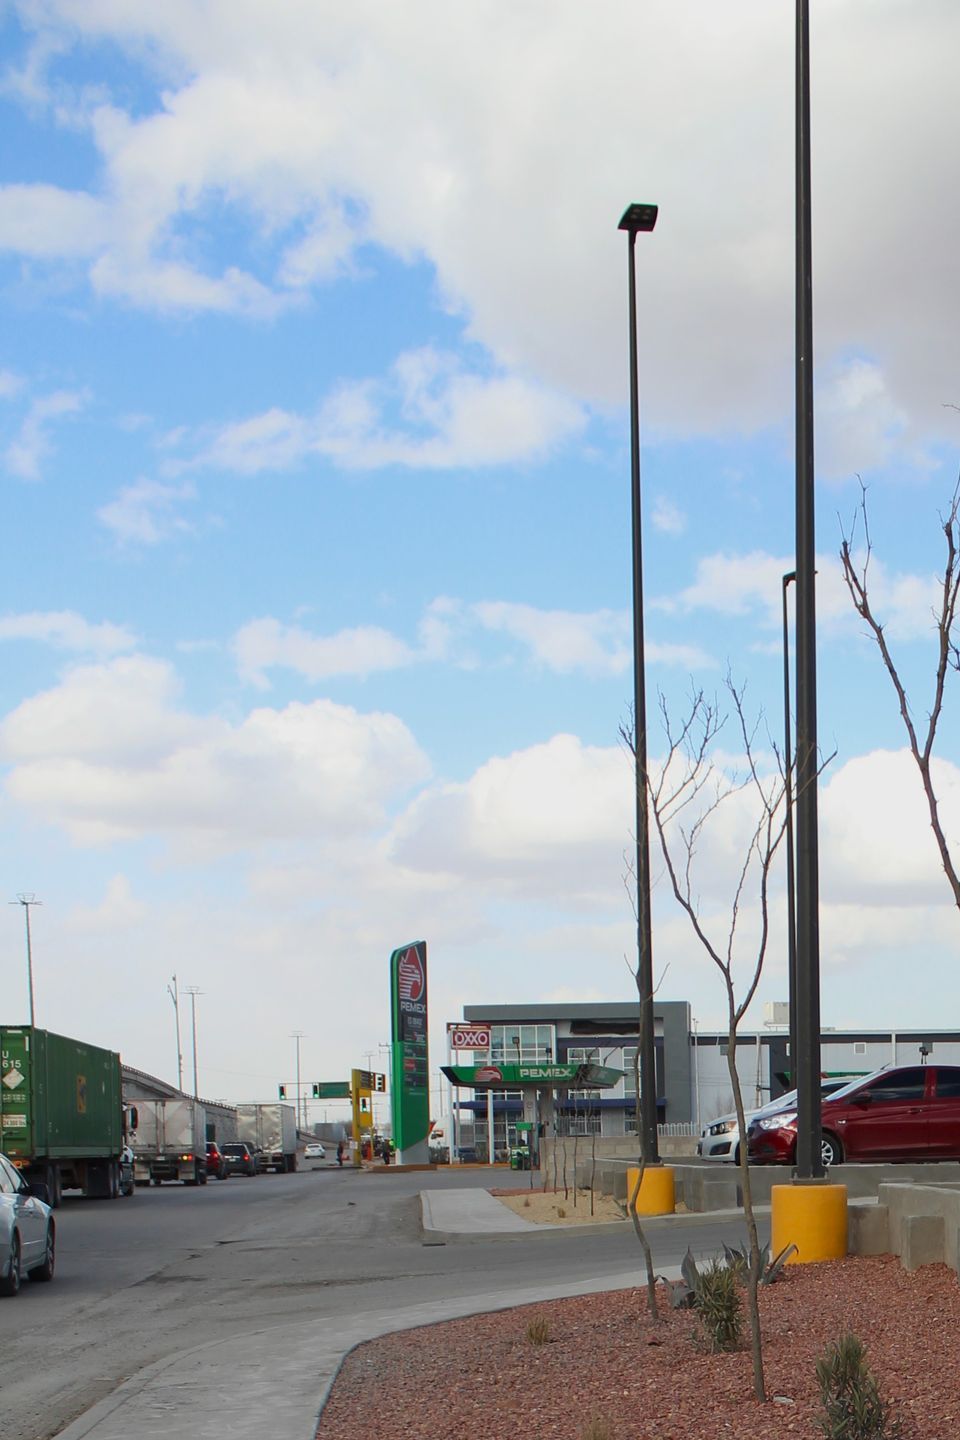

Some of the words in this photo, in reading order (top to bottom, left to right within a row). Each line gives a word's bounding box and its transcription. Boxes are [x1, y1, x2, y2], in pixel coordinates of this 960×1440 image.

[401, 1001, 426, 1013] PEMEX
[455, 1032, 488, 1045] OXXO
[520, 1068, 571, 1078] PEMEX
